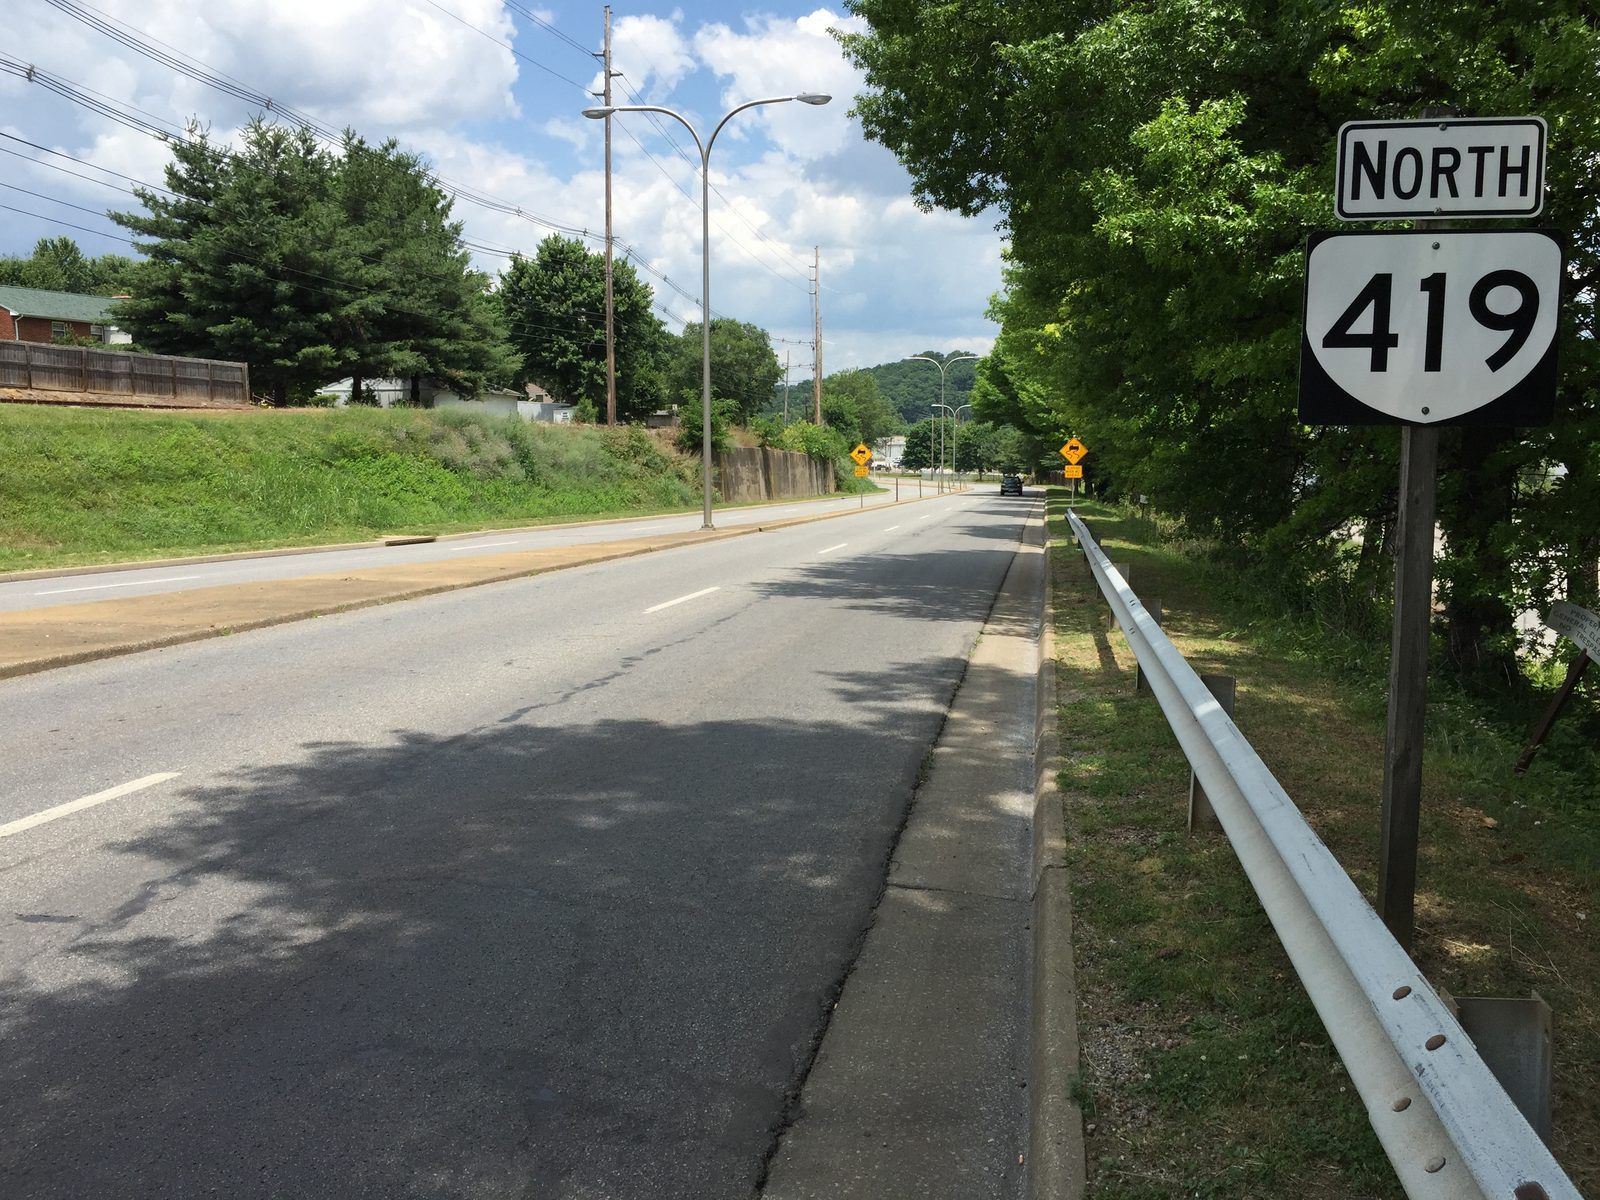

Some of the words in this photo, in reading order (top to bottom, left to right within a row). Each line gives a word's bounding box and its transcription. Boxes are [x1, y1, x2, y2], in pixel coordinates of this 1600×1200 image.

[1351, 140, 1530, 200] NORTH
[1322, 269, 1540, 373] 419
[1559, 622, 1571, 632] NO
